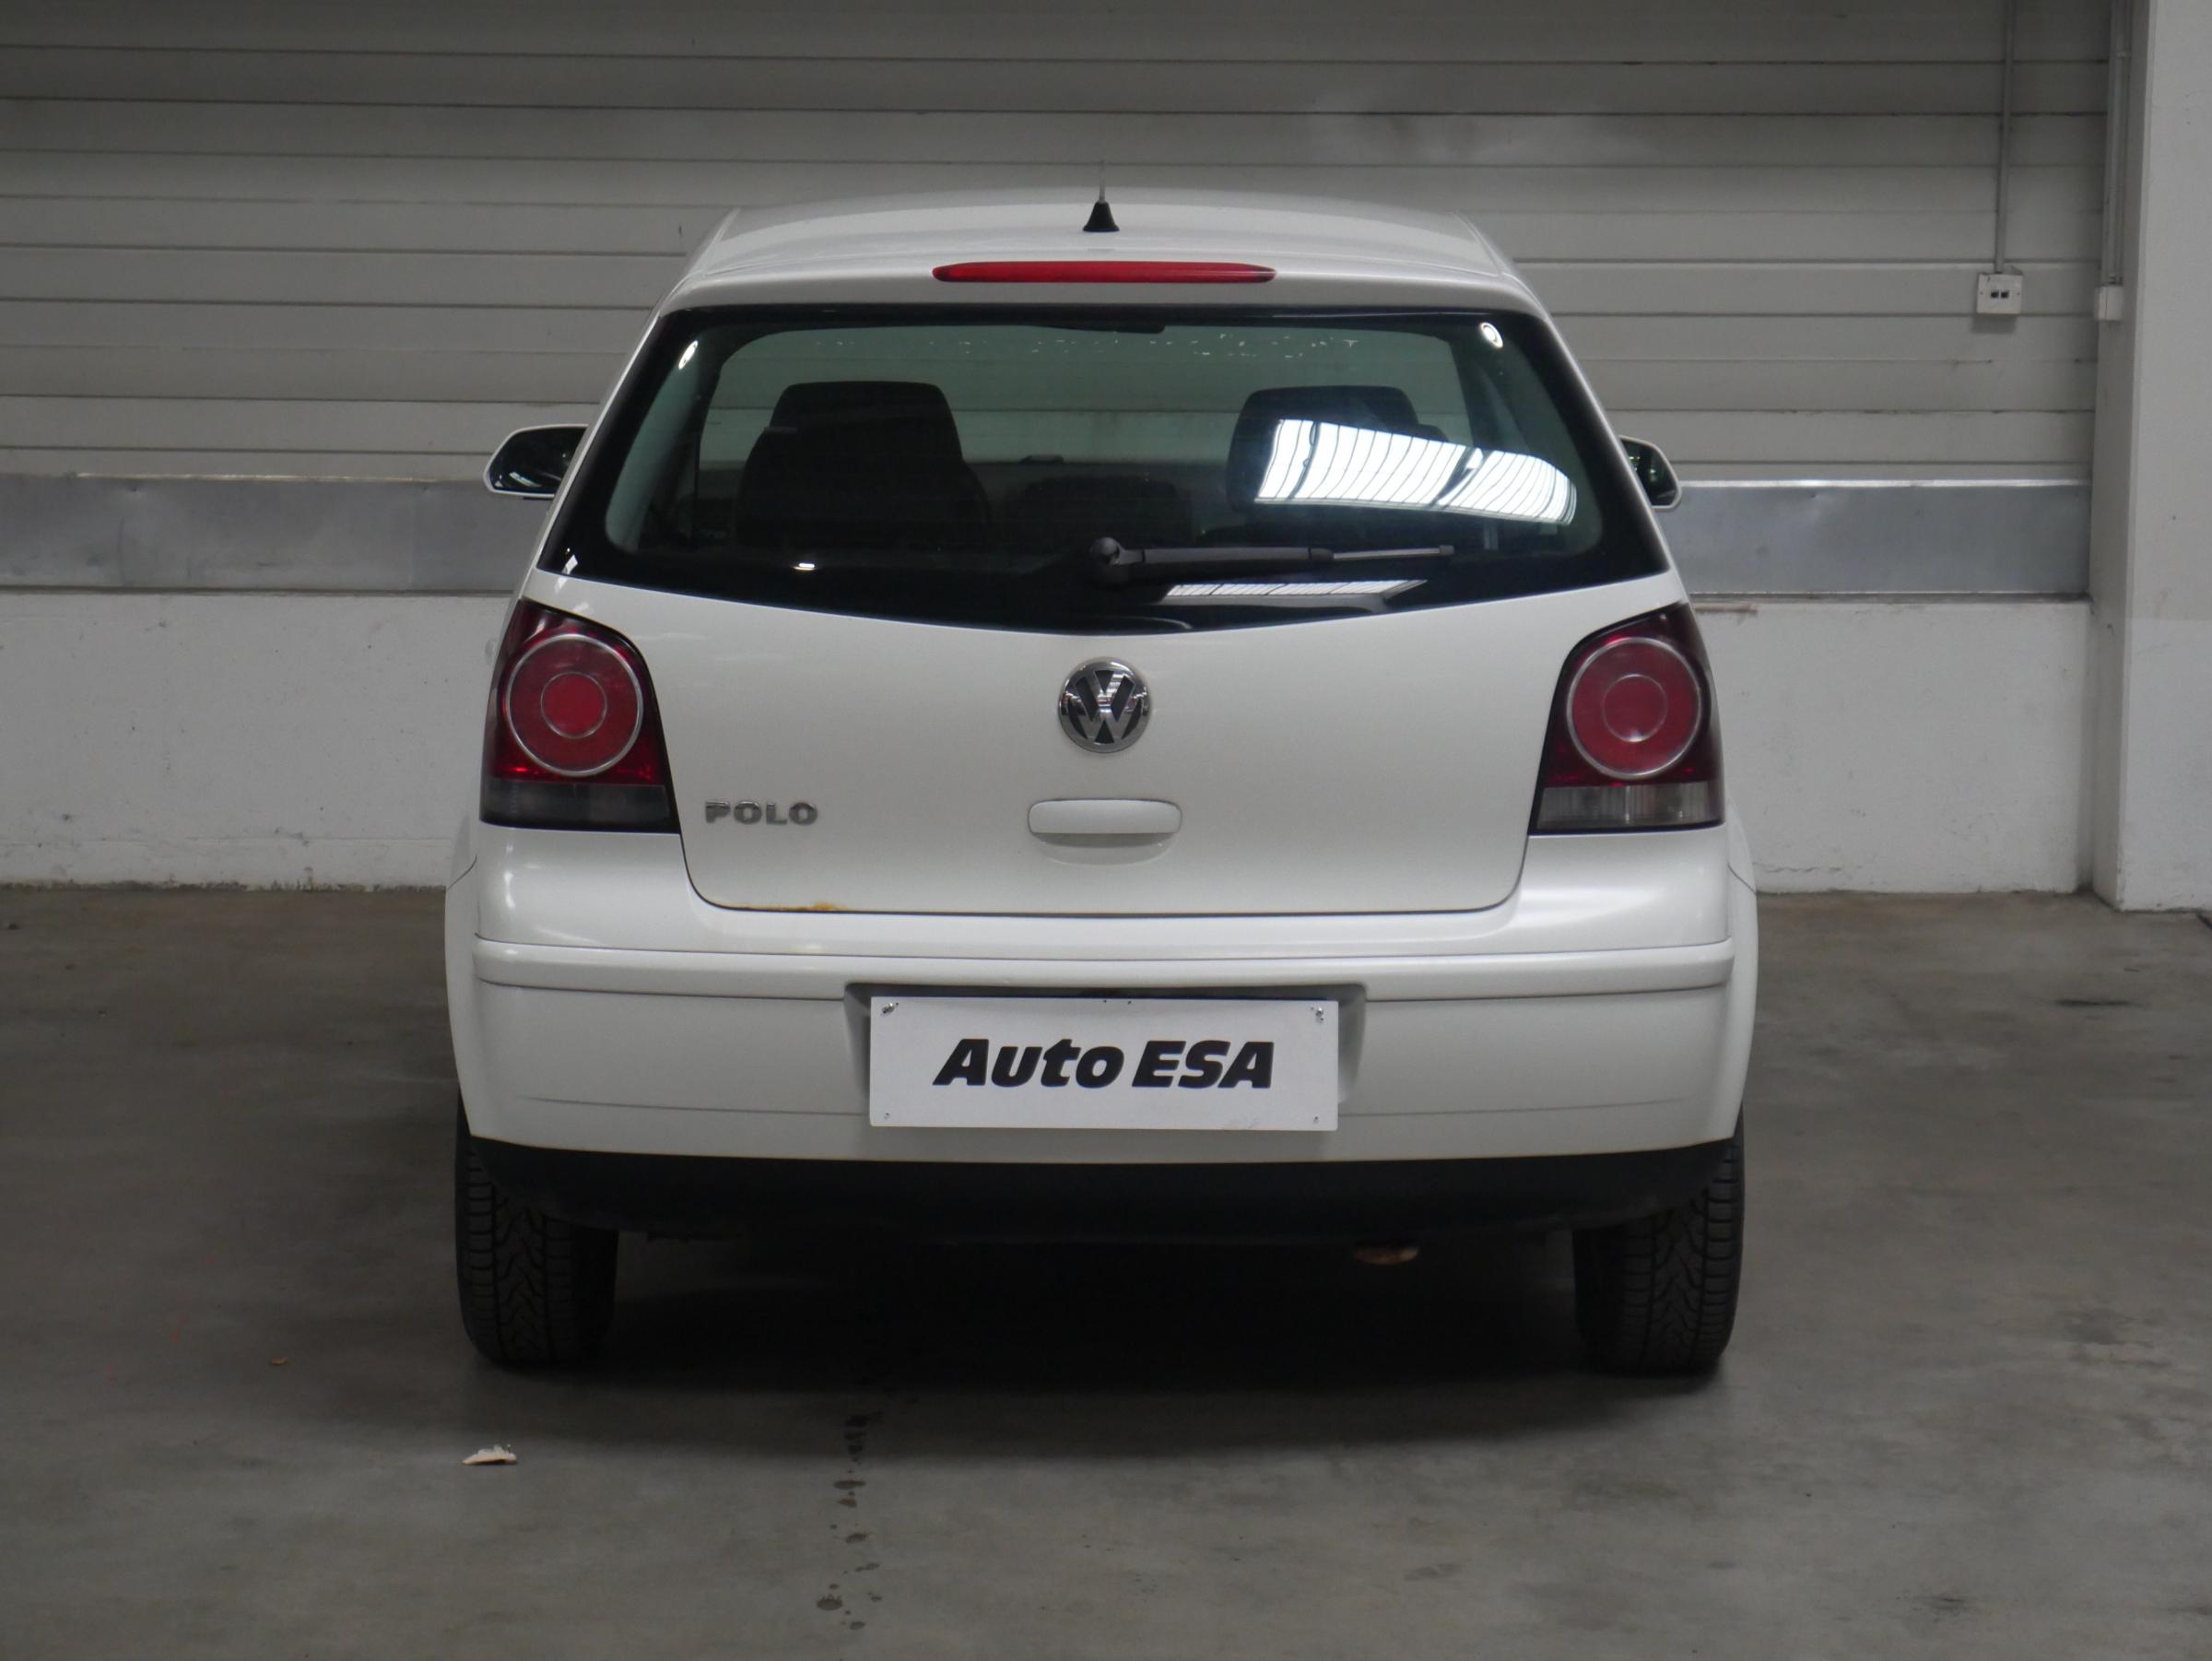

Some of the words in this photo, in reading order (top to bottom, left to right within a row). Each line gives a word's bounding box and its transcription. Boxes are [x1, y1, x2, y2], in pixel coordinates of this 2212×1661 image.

[705, 800, 818, 825] POLO
[933, 1038, 1124, 1089] Auto
[1132, 1041, 1275, 1089] ESA
